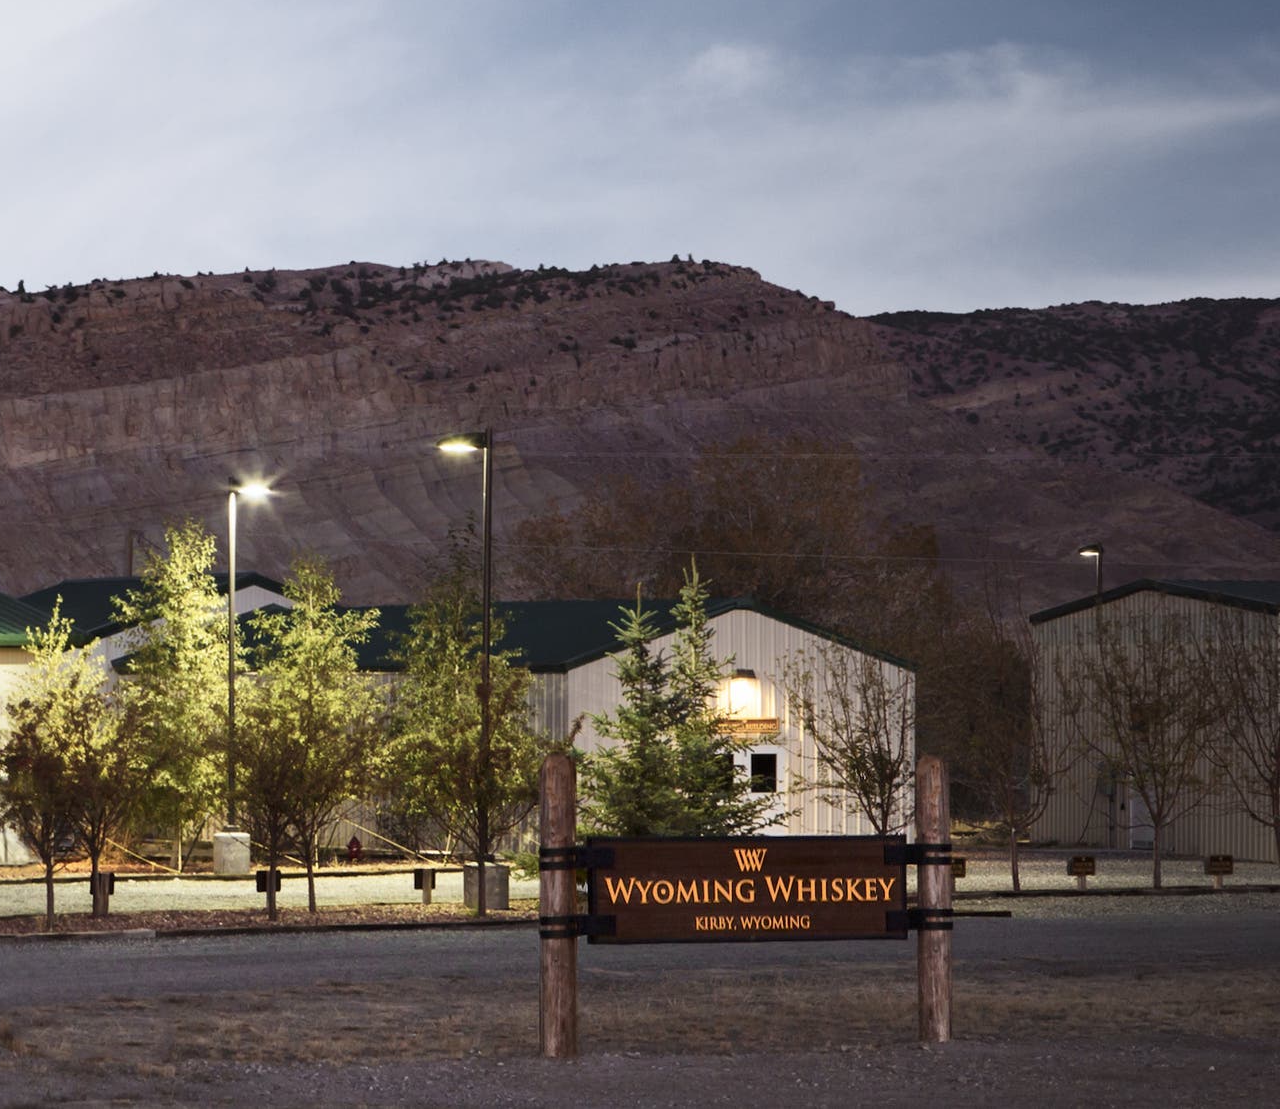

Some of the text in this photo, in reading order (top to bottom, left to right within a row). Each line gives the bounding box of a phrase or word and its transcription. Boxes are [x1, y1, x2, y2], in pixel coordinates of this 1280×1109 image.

[604, 875, 896, 905] WYOMING WHISKEY
[694, 915, 811, 931] KIRBY, WYOMING
